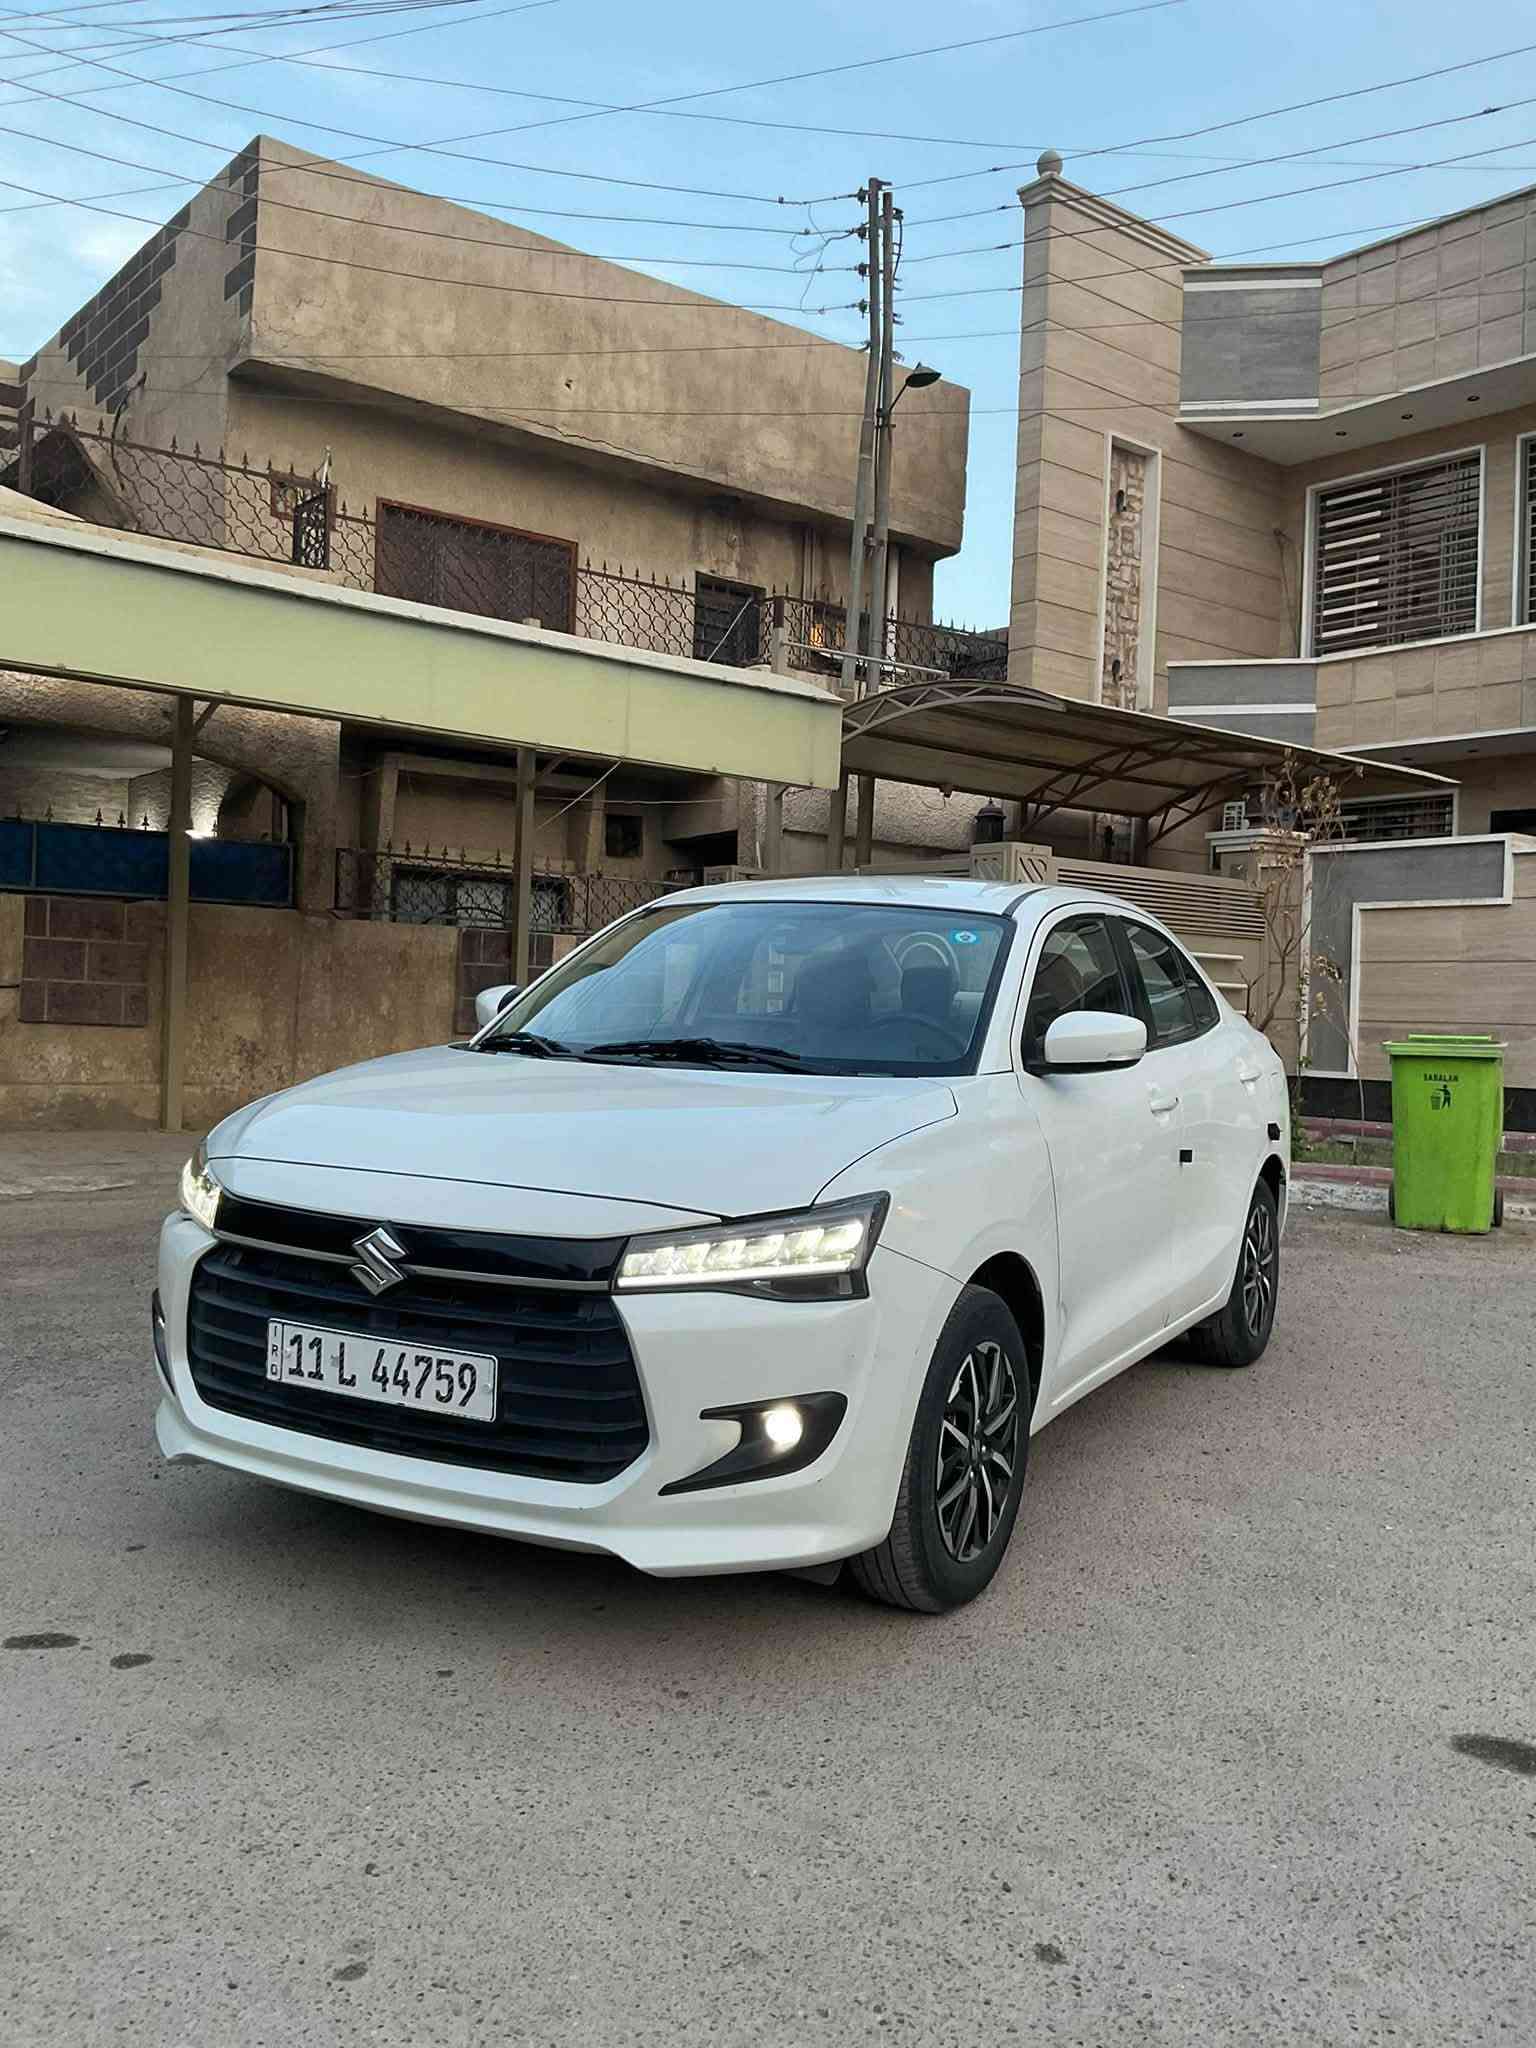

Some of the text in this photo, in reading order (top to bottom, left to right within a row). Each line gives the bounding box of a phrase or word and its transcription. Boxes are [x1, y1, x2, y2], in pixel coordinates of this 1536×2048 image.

[288, 1334, 477, 1407] 11 L 44759
